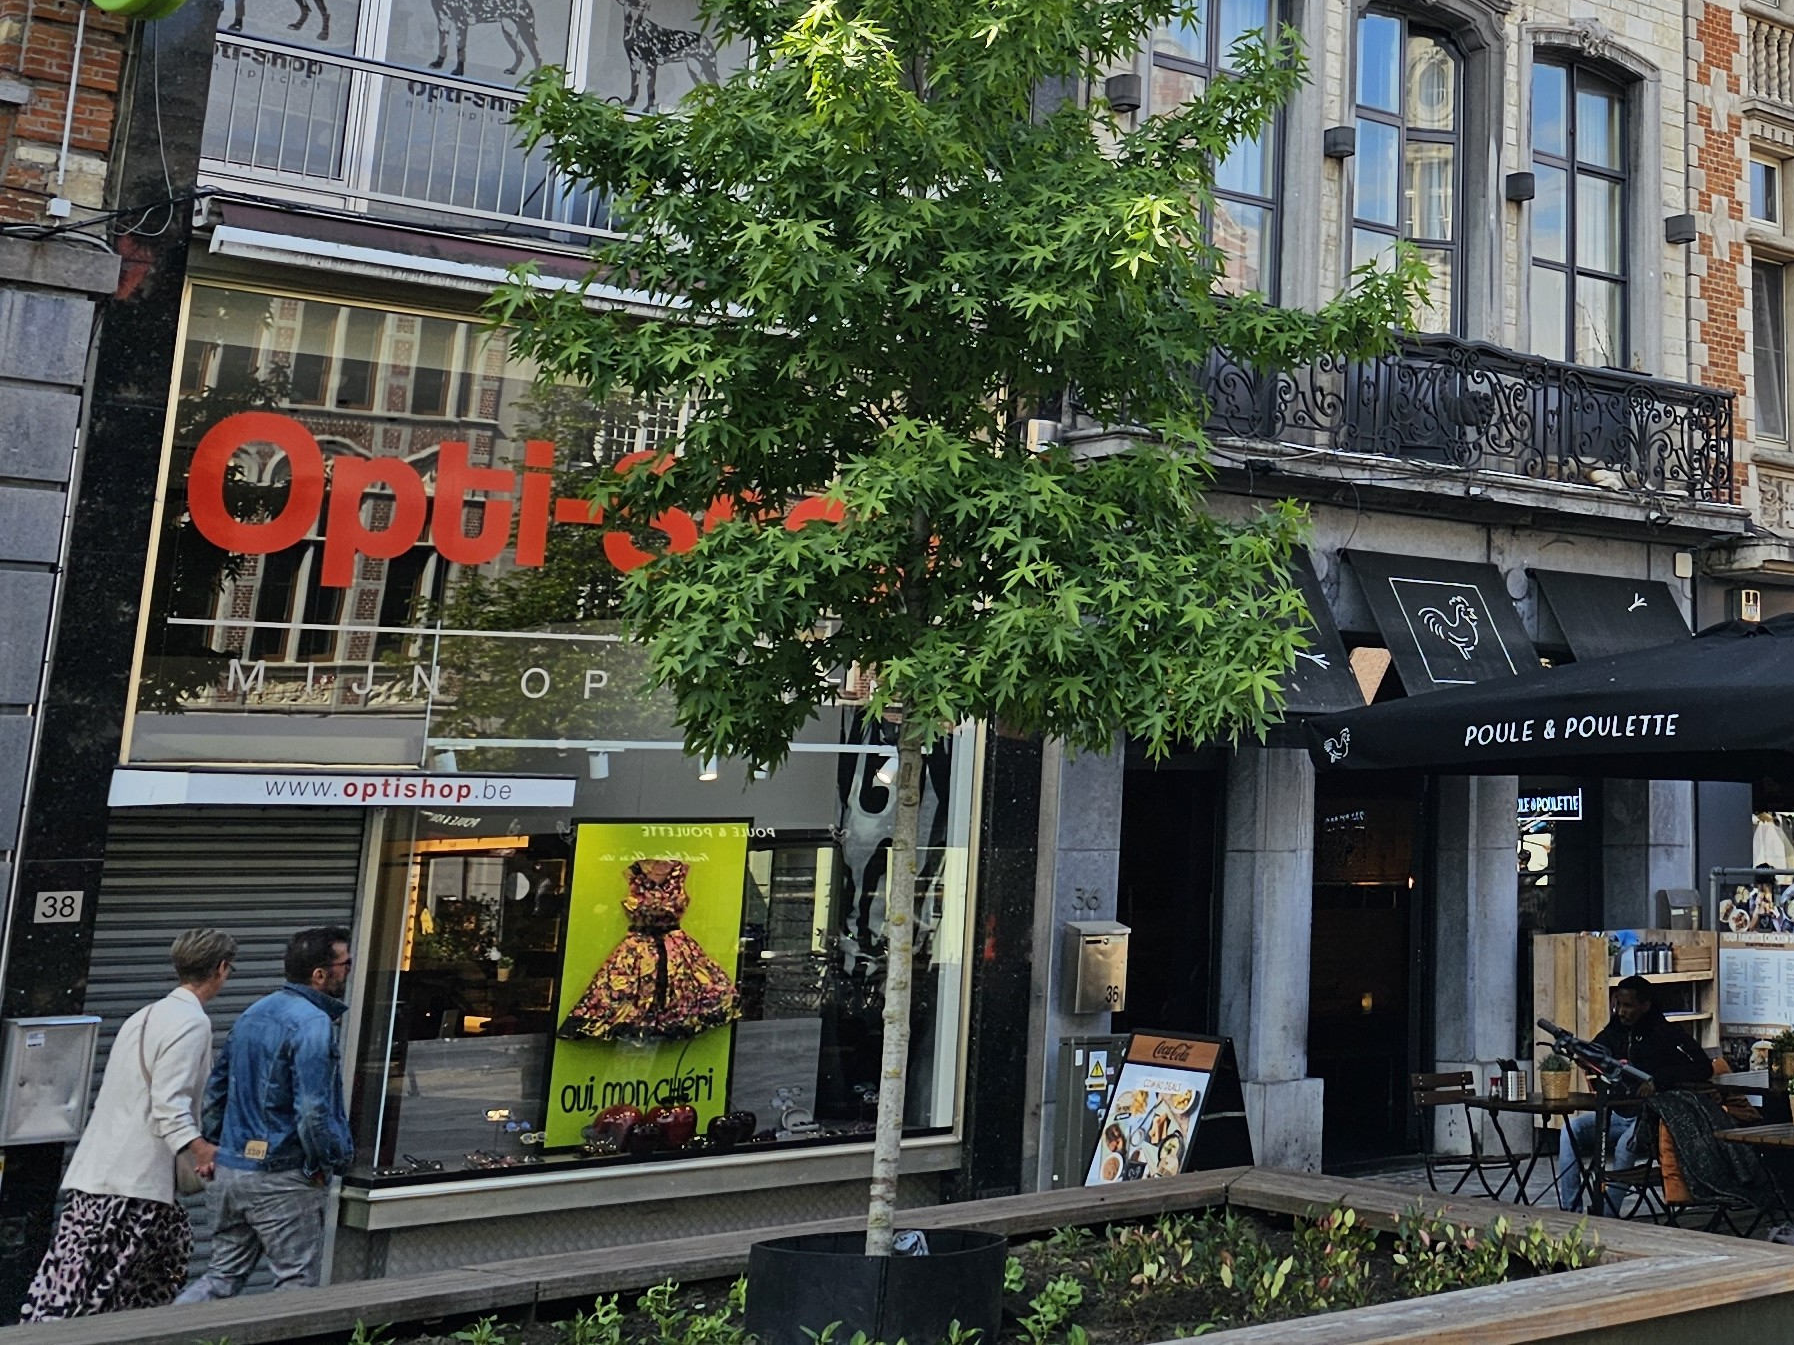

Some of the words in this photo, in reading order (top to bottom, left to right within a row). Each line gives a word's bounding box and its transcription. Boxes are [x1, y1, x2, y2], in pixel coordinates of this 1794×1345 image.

[188, 411, 846, 587] Opti-S
[227, 658, 441, 696] MIJN
[1464, 720, 1535, 747] POULE
[1543, 718, 1556, 740] &
[1564, 713, 1679, 739] POULETTE
[265, 778, 512, 802] www.optishop.be
[1536, 796, 1579, 812] POULETTE
[41, 895, 75, 919] 38
[1072, 888, 1100, 910] 36
[1105, 985, 1119, 1003] 36
